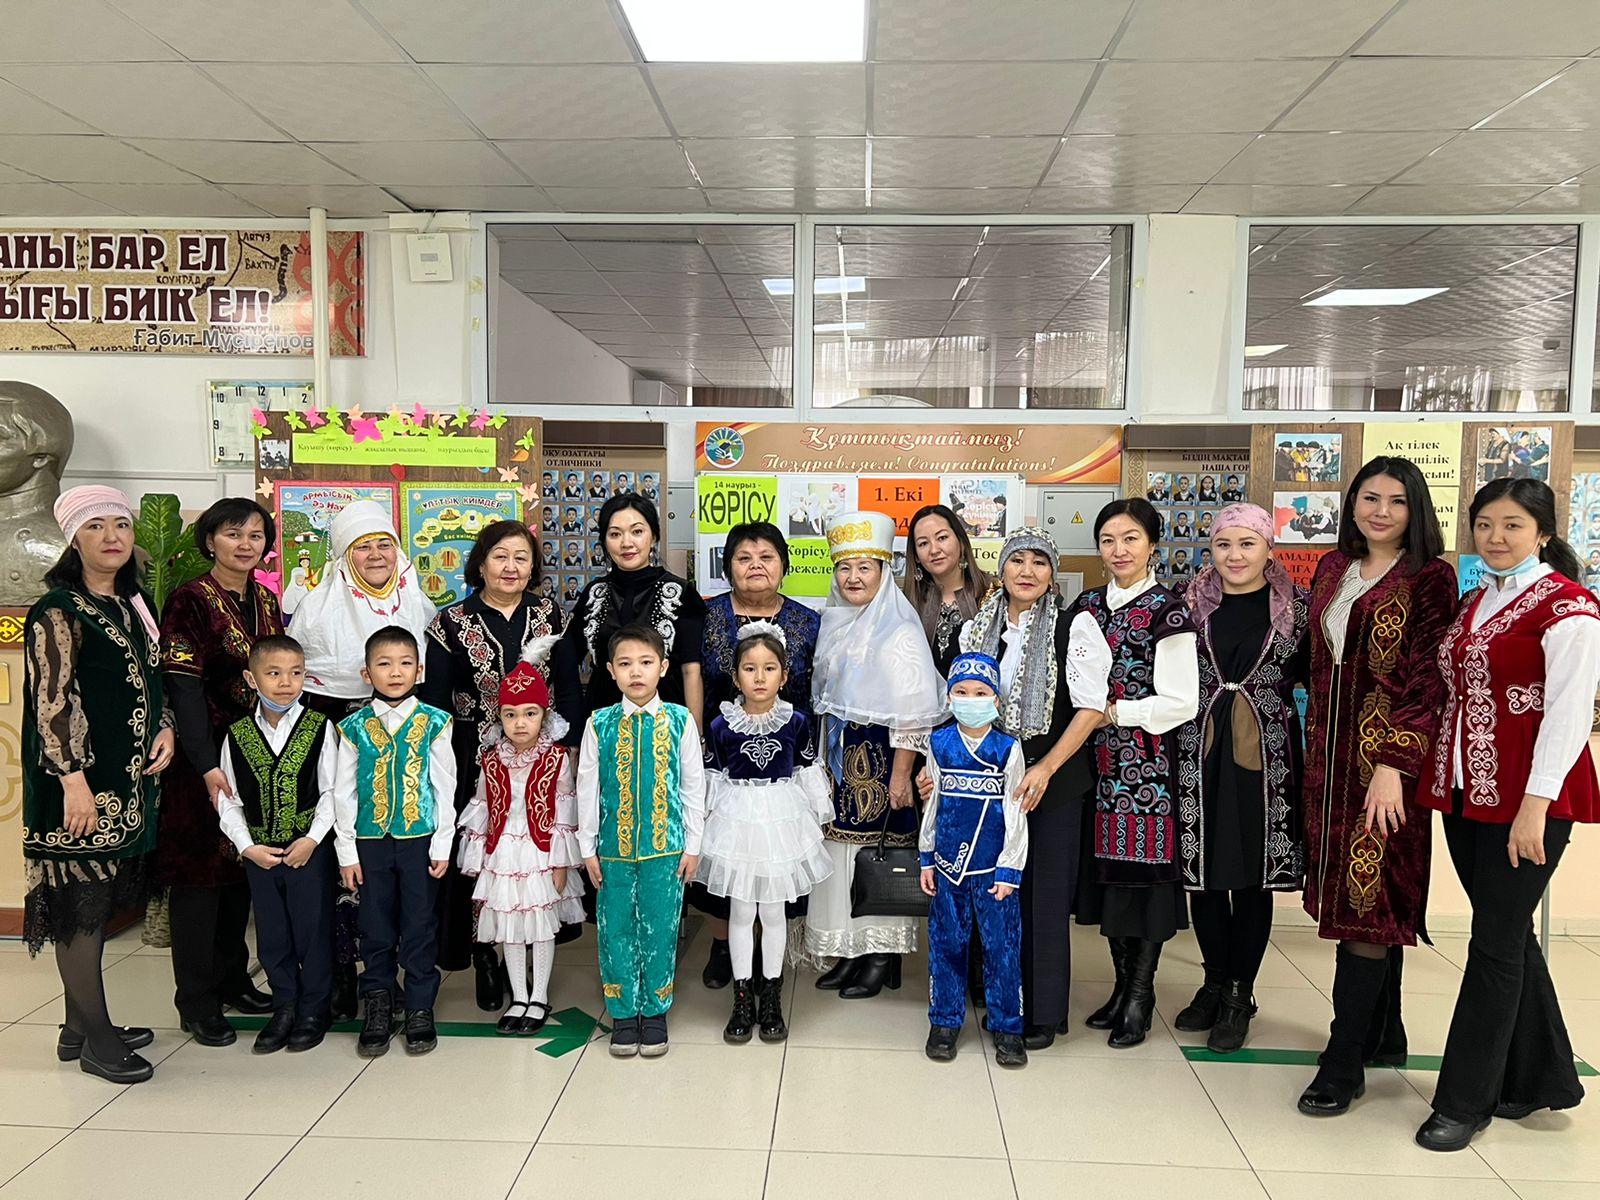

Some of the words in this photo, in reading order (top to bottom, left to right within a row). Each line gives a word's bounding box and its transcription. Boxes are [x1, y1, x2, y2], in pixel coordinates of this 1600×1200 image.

[90, 236, 165, 270] БАР
[179, 237, 226, 270] ЕЛ
[104, 288, 196, 322] БИІК
[209, 290, 271, 323] ЕЛ!
[134, 329, 196, 346] Ғабит
[235, 387, 242, 397] 11
[257, 386, 266, 396] 12
[282, 387, 286, 396] 1
[216, 393, 225, 403] 10
[301, 394, 308, 403] 2
[213, 420, 220, 430] 9
[802, 426, 1025, 452] Құттықтаймыз!
[1384, 441, 1404, 450] Ақ
[1407, 440, 1440, 450] тілек
[218, 447, 225, 456] 8
[561, 450, 606, 458] ОЗАТТАРЫ
[238, 453, 244, 462] 7
[761, 454, 902, 473] Поздравляем!
[907, 457, 1056, 473] Congratulations!
[1424, 469, 1454, 478] сын!
[874, 487, 888, 501] 1.
[895, 486, 924, 501] Екі
[699, 491, 776, 525] КӨРІСУ
[787, 565, 835, 576] режеле
